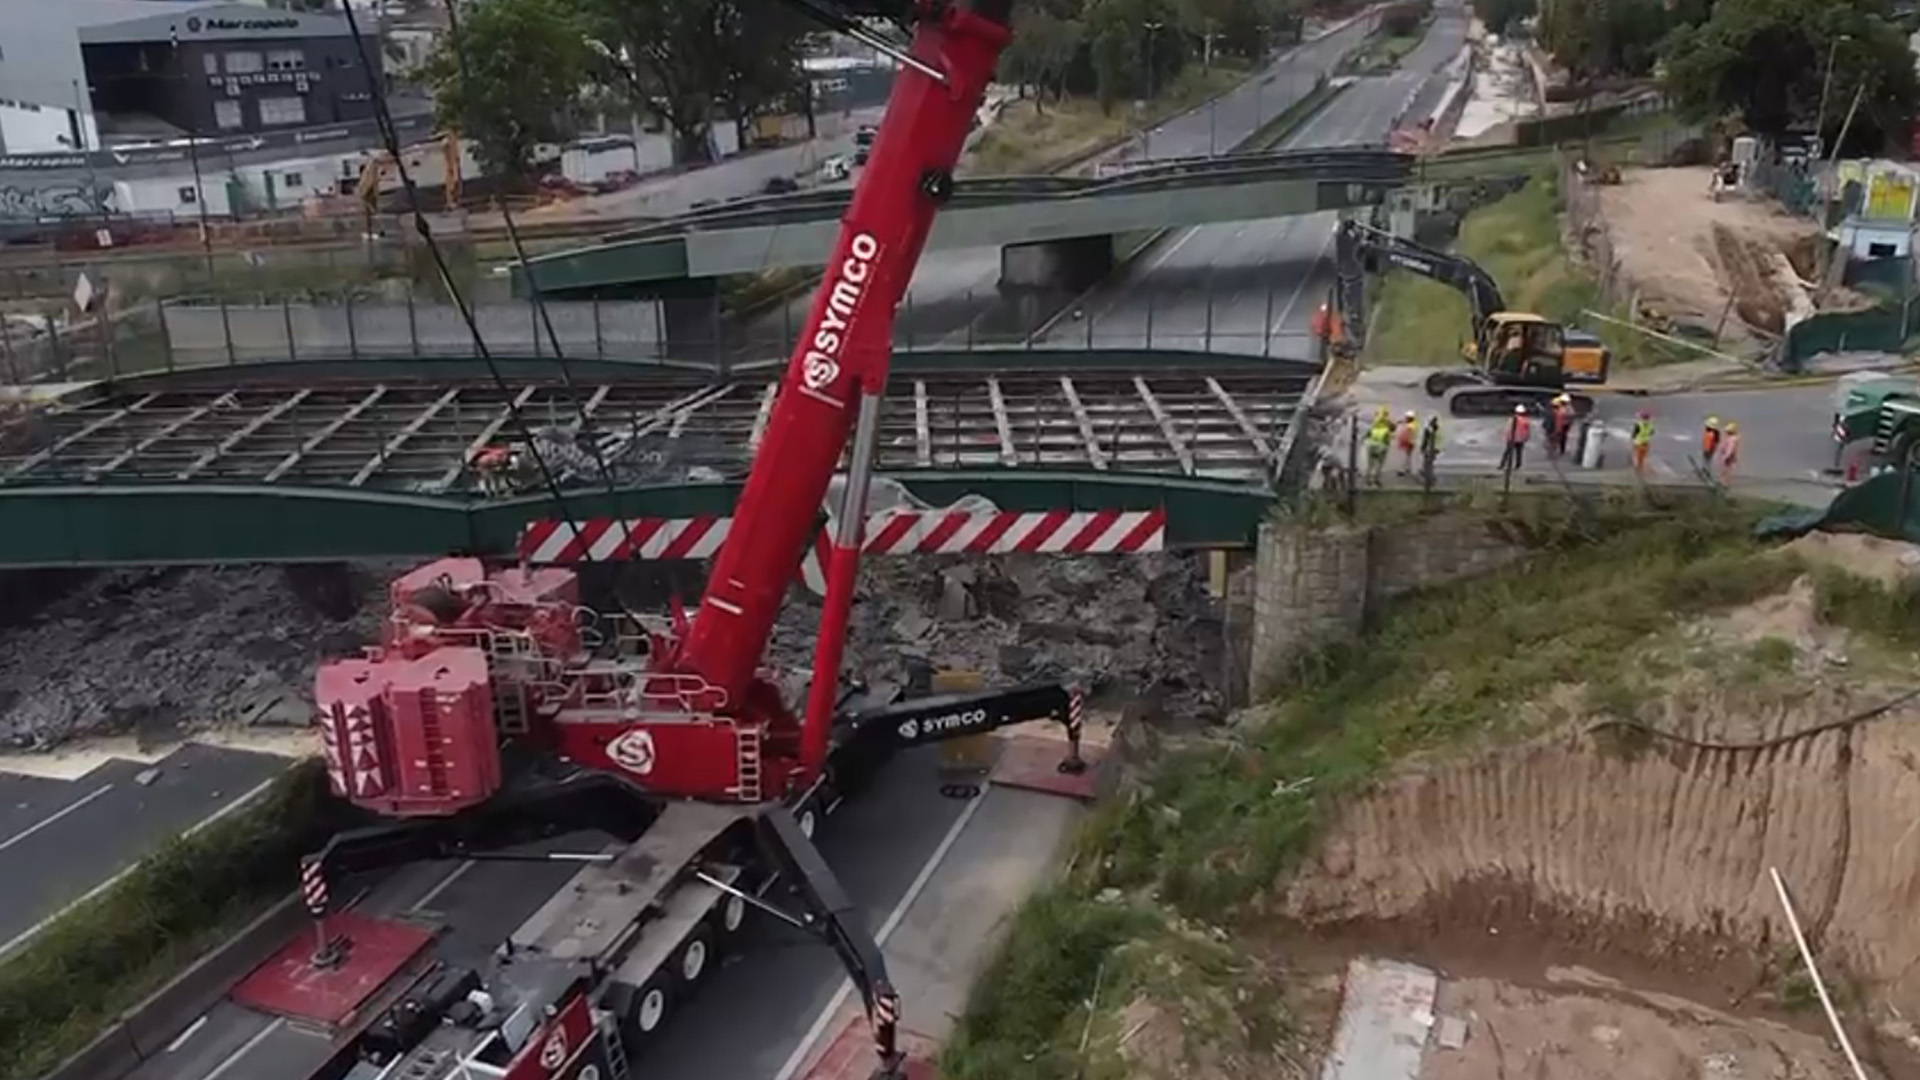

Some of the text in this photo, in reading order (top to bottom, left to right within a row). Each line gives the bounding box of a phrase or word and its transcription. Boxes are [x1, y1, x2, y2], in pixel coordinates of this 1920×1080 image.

[206, 18, 299, 30] Marcopolo
[0, 158, 85, 167] Marcopolo
[814, 233, 877, 354] SYMCO
[923, 708, 986, 733] SYMCO
